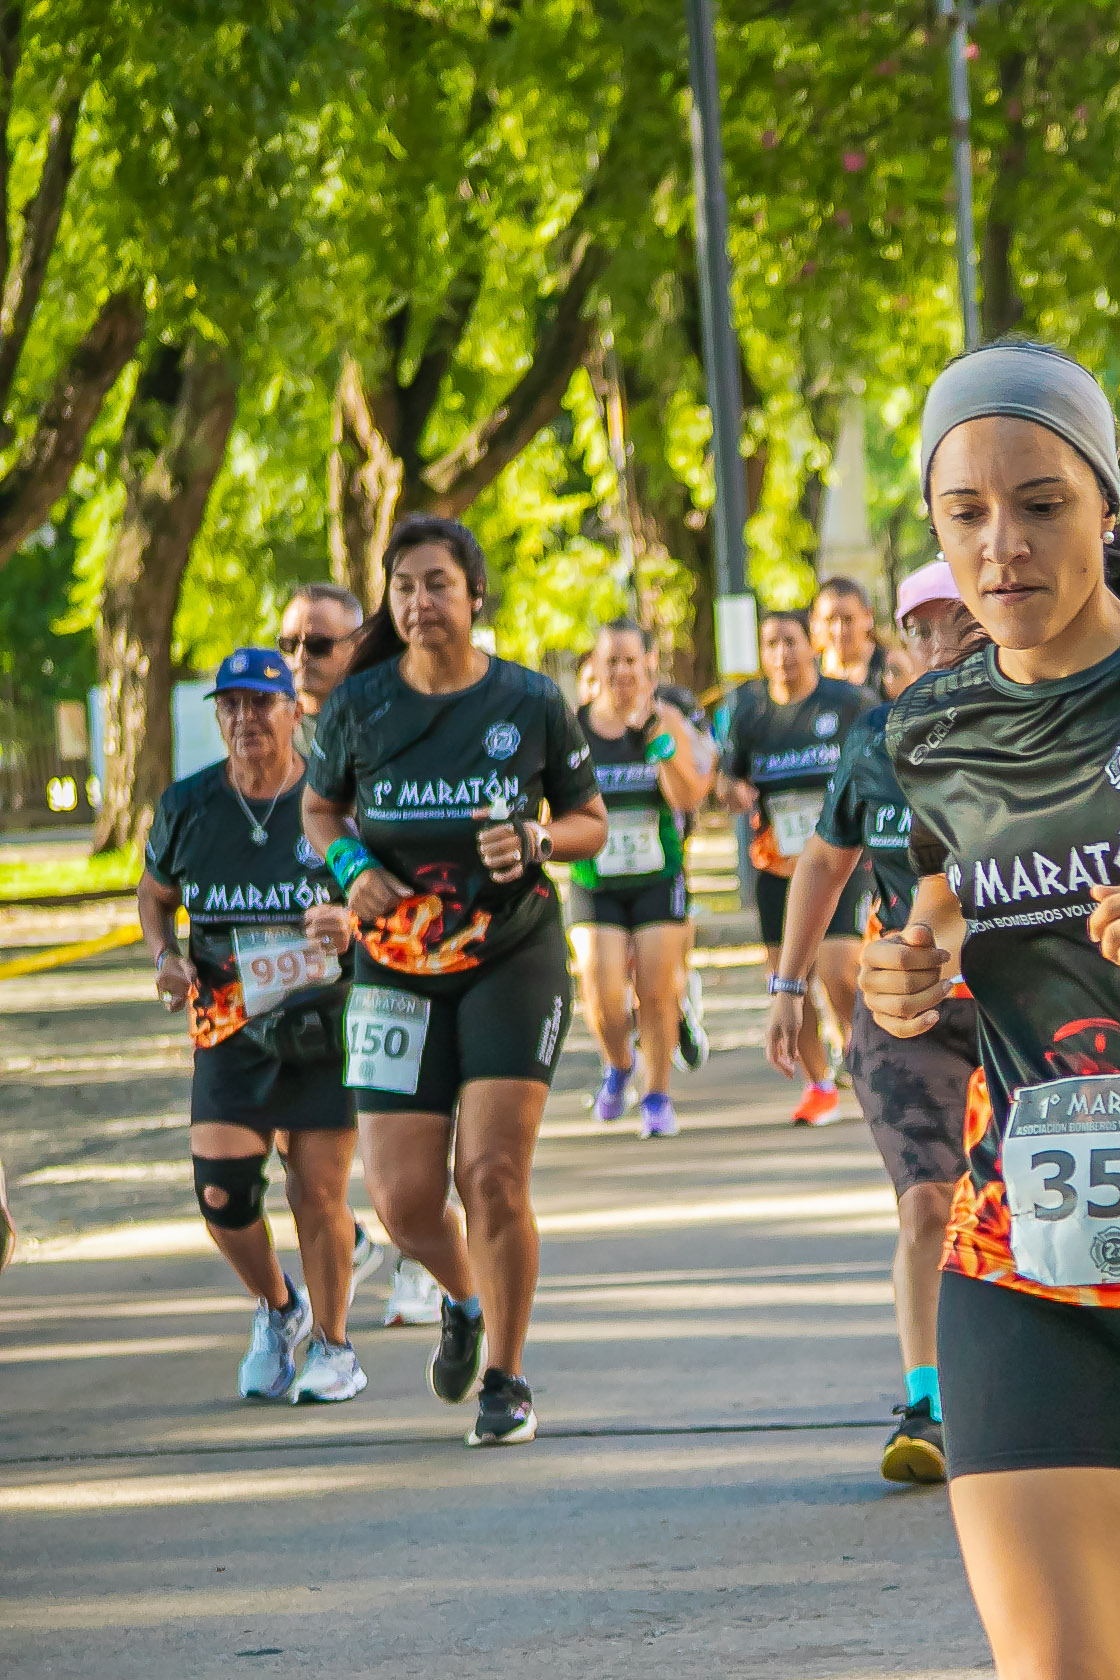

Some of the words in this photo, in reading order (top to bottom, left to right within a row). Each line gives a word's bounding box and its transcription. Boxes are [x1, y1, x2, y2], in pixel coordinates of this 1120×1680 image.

[399, 769, 519, 806] MARATÓN
[996, 907, 1063, 930] BOMBEROS
[350, 1021, 410, 1059] 150
